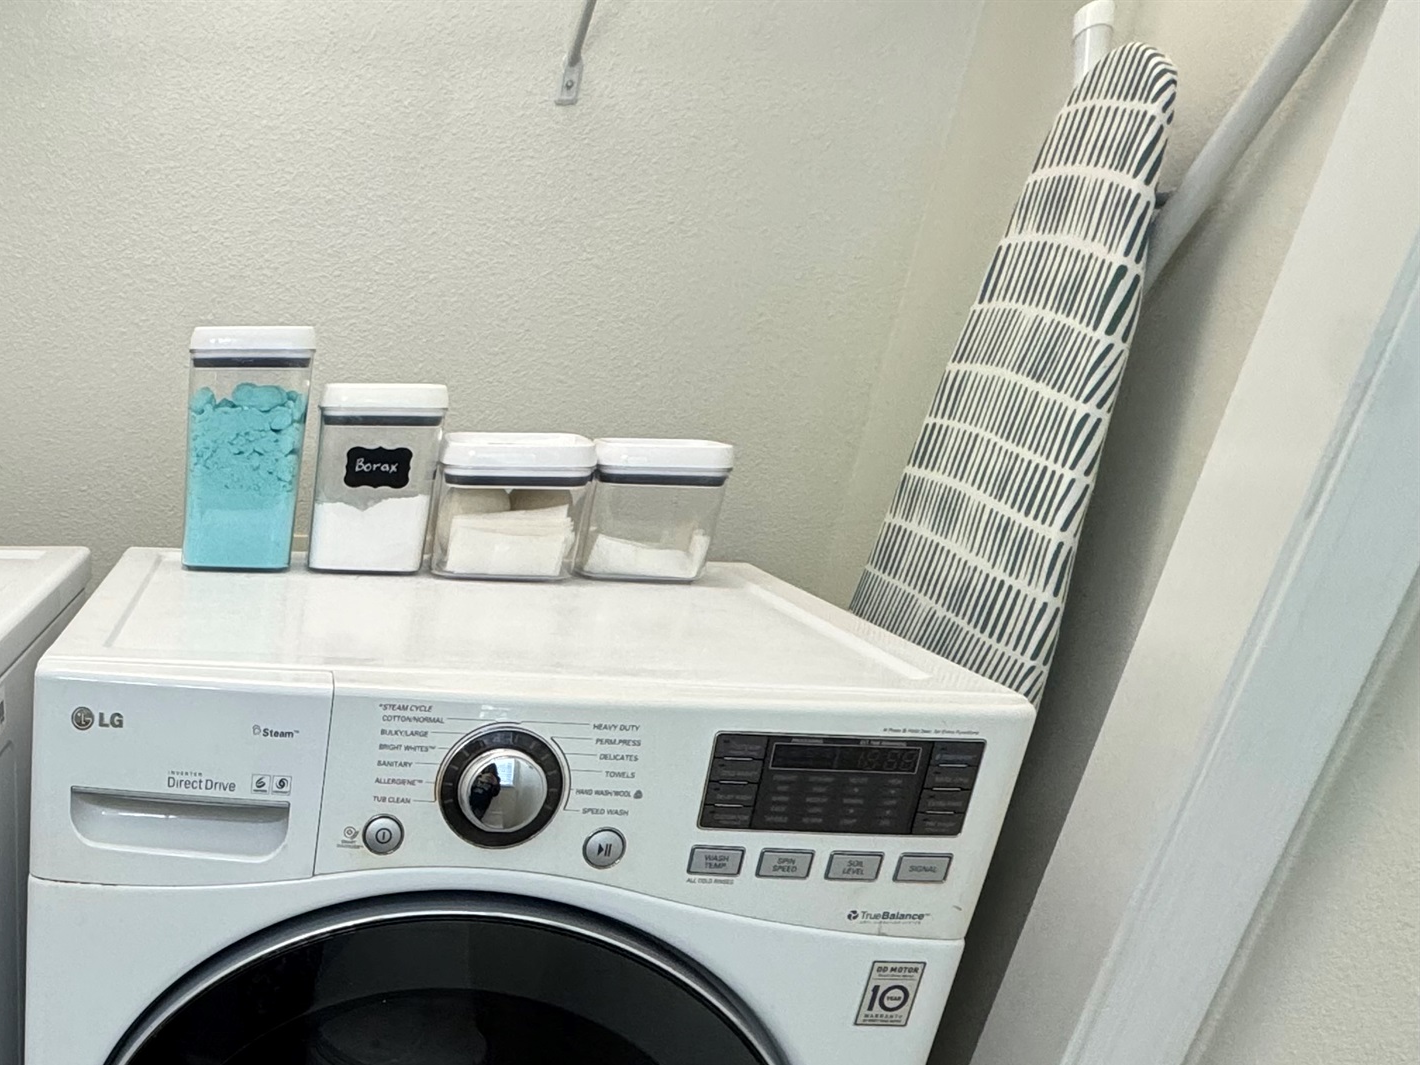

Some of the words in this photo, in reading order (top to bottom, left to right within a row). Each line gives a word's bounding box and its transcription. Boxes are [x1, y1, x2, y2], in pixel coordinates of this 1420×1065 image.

[355, 457, 399, 474] Borax
[409, 704, 433, 713] CYCLE
[98, 712, 124, 729] LG
[382, 714, 445, 724] COTTON/NORMAL
[592, 723, 618, 731] HEAVY
[619, 724, 640, 732] DUTY
[380, 728, 429, 738] BULKY/LARGE
[378, 743, 402, 751] BRIGHT
[599, 753, 639, 762] DELICATES
[376, 760, 413, 768] SANITARY
[605, 770, 636, 779] TOWELS
[167, 776, 203, 790] Direct
[204, 779, 236, 792] Drive
[373, 795, 387, 803] TUB
[387, 796, 411, 804] CLEAN
[582, 807, 606, 815] SPEED
[606, 808, 629, 816] WASH
[704, 854, 729, 862] WASH
[776, 857, 796, 865] SPIN
[772, 865, 798, 873] SPEED
[842, 868, 864, 876] LEVEL
[909, 865, 938, 873] SIGNAL
[890, 966, 920, 974] MOTOR
[867, 984, 910, 1012] 10
